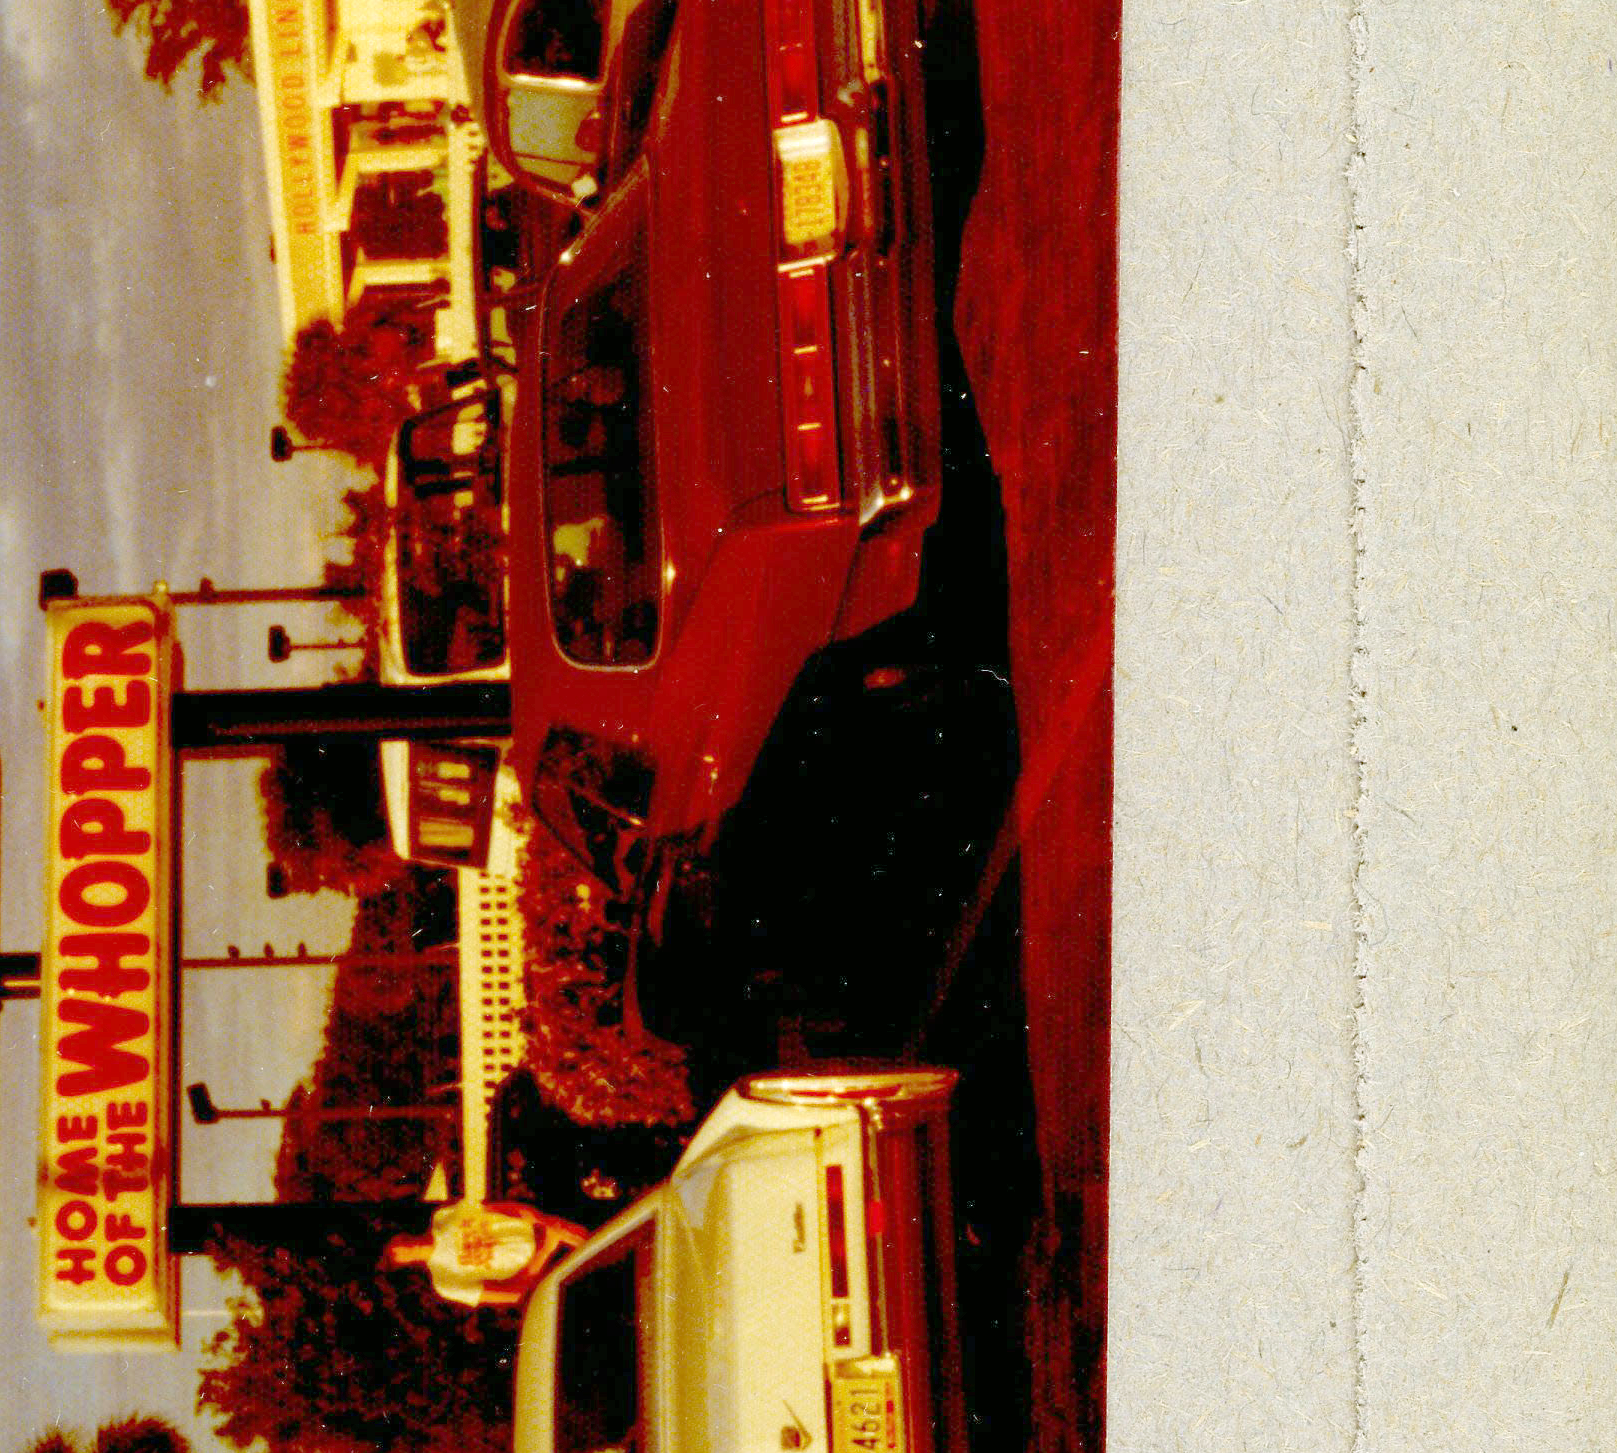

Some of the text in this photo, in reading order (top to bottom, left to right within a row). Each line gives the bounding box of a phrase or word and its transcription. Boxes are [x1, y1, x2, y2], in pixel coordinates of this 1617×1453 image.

[281, 75, 316, 236] HOLLYWOOD
[57, 619, 152, 1096] WHOPPER
[57, 1114, 98, 1283] HOME
[106, 1101, 147, 1285] OF THE
